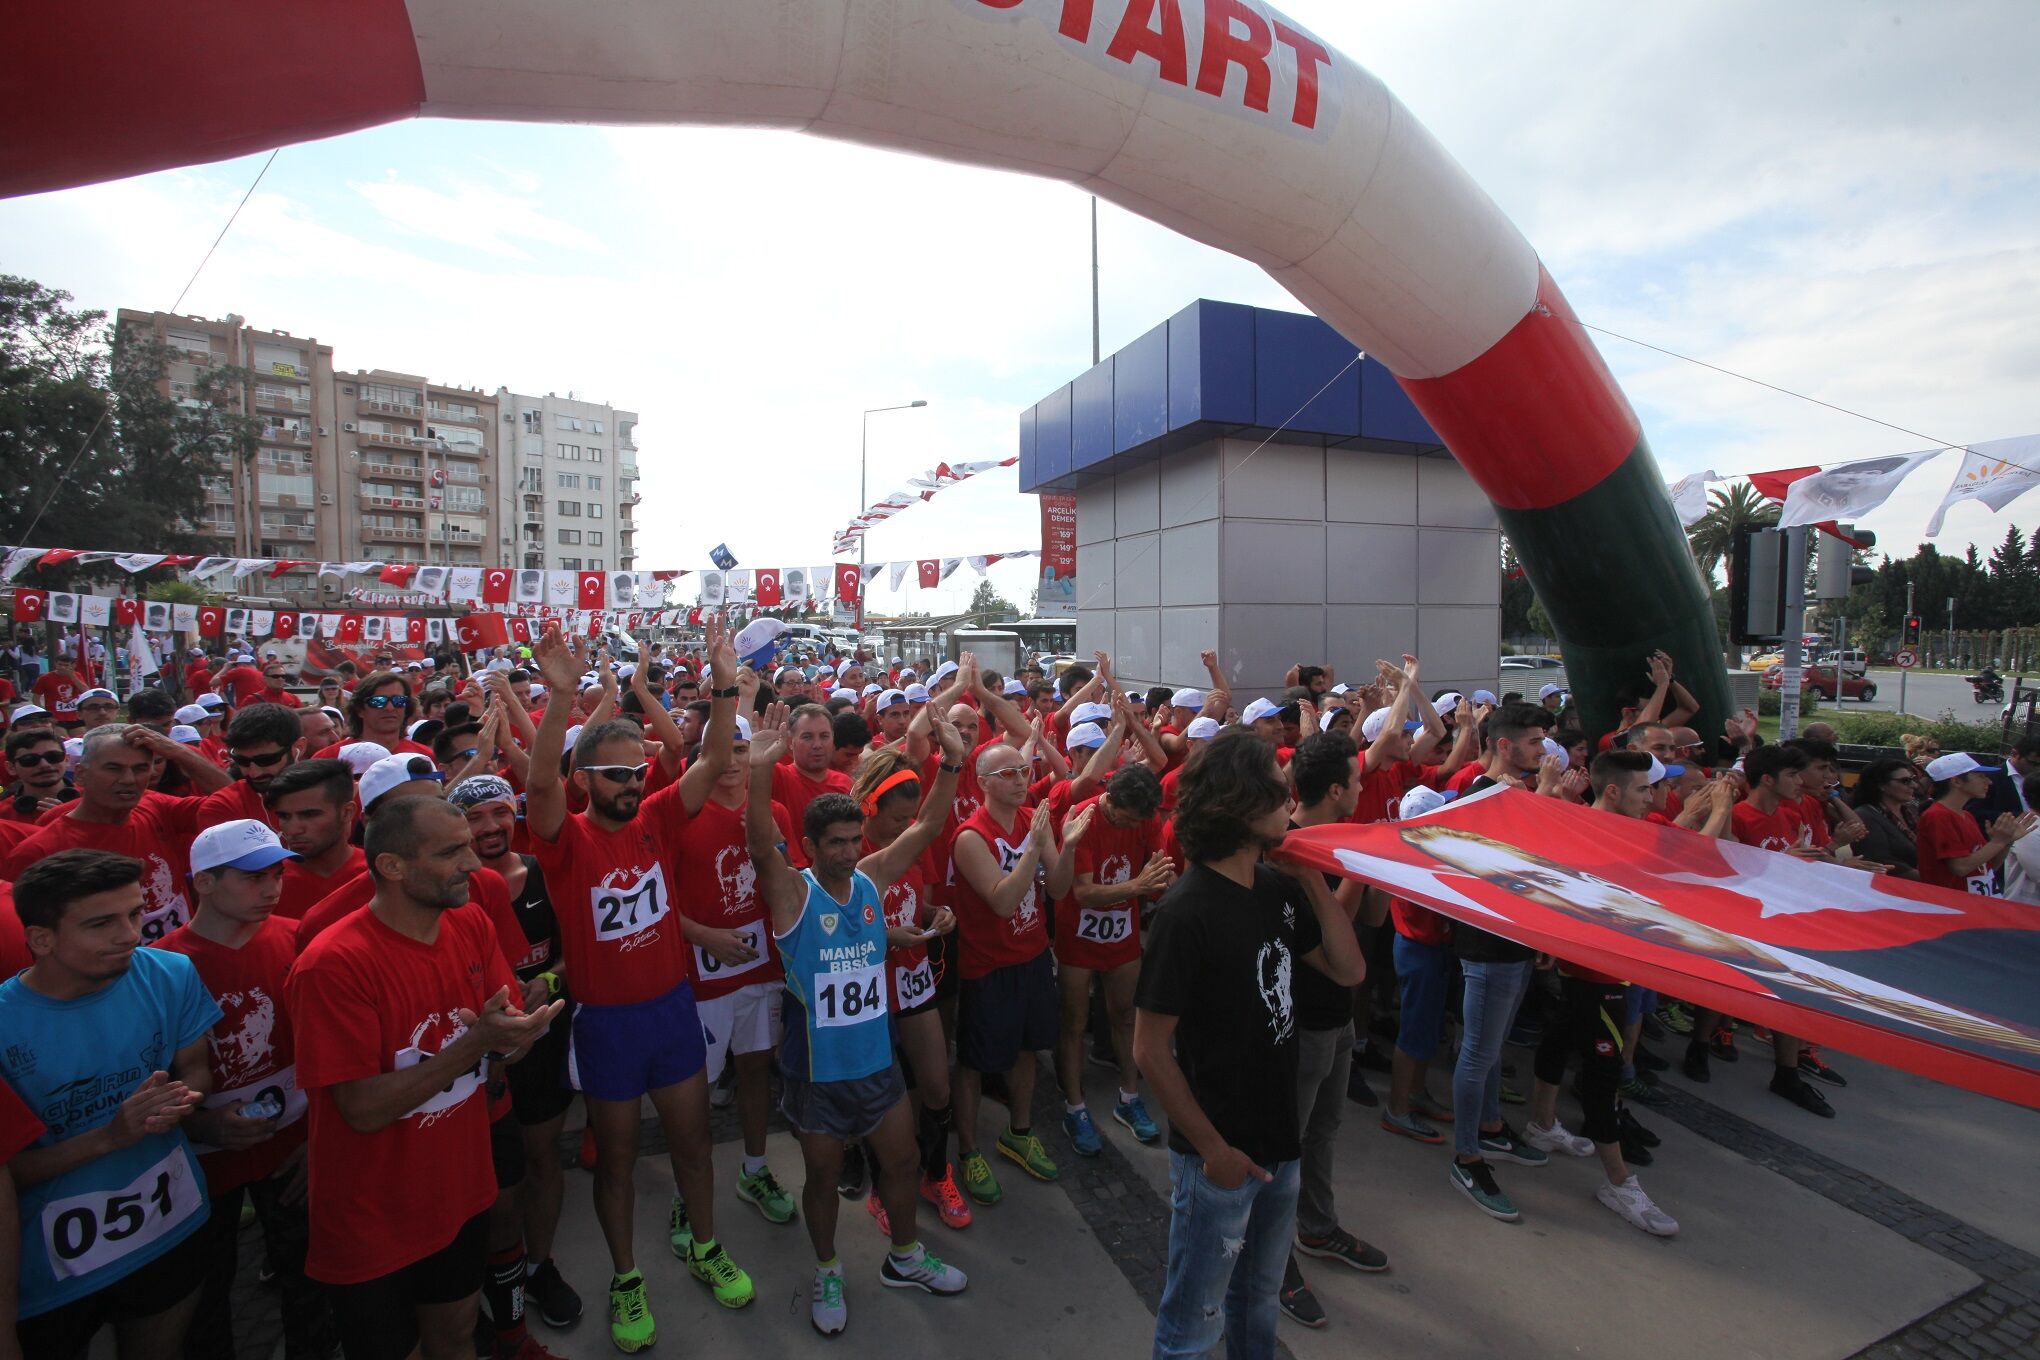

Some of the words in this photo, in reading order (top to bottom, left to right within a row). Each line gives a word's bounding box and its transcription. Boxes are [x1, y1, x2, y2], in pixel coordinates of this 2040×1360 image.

[974, 0, 1332, 130] ART
[1051, 514, 1075, 523] DEMEK
[598, 877, 660, 932] 277
[1082, 914, 1126, 939] 203
[819, 940, 877, 961] MANİSA
[830, 955, 870, 974] BBSK
[819, 976, 880, 1019] 184
[103, 1066, 142, 1093] Run
[53, 1171, 173, 1260] 051
